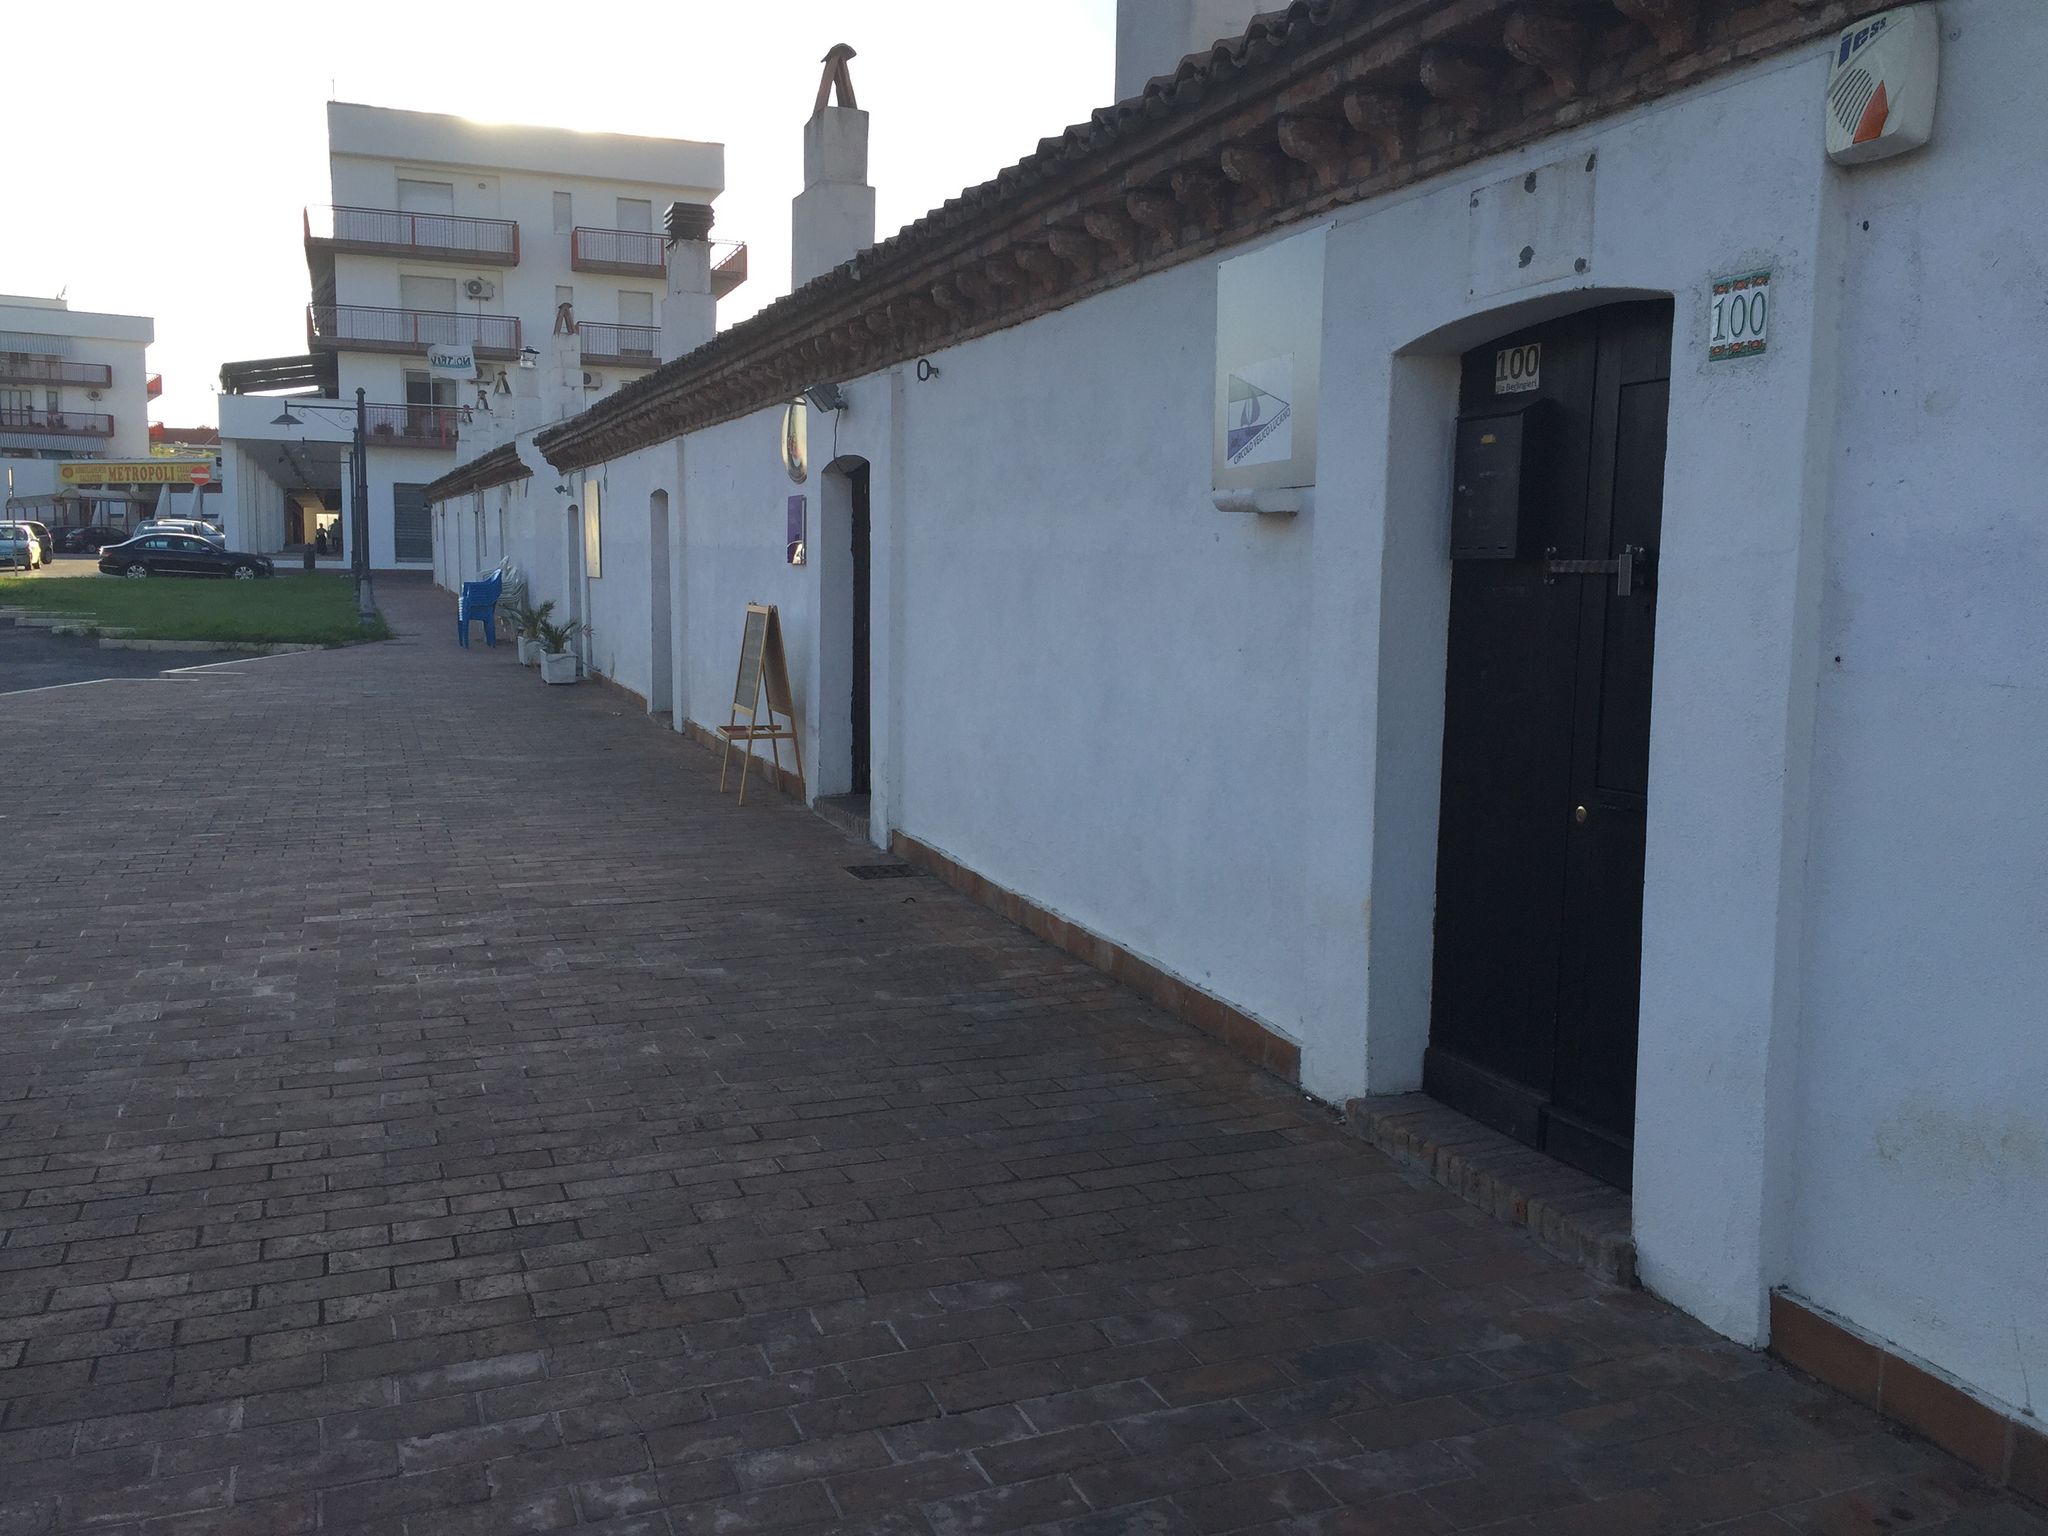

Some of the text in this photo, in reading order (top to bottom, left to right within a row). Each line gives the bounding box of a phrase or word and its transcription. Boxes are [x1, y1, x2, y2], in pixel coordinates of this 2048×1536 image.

[1713, 291, 1766, 341] 100
[1497, 345, 1539, 381] 100
[1234, 441, 1254, 464] CIRCOLO
[1270, 407, 1291, 432] LUCANO
[108, 465, 175, 481] METROPOLI
